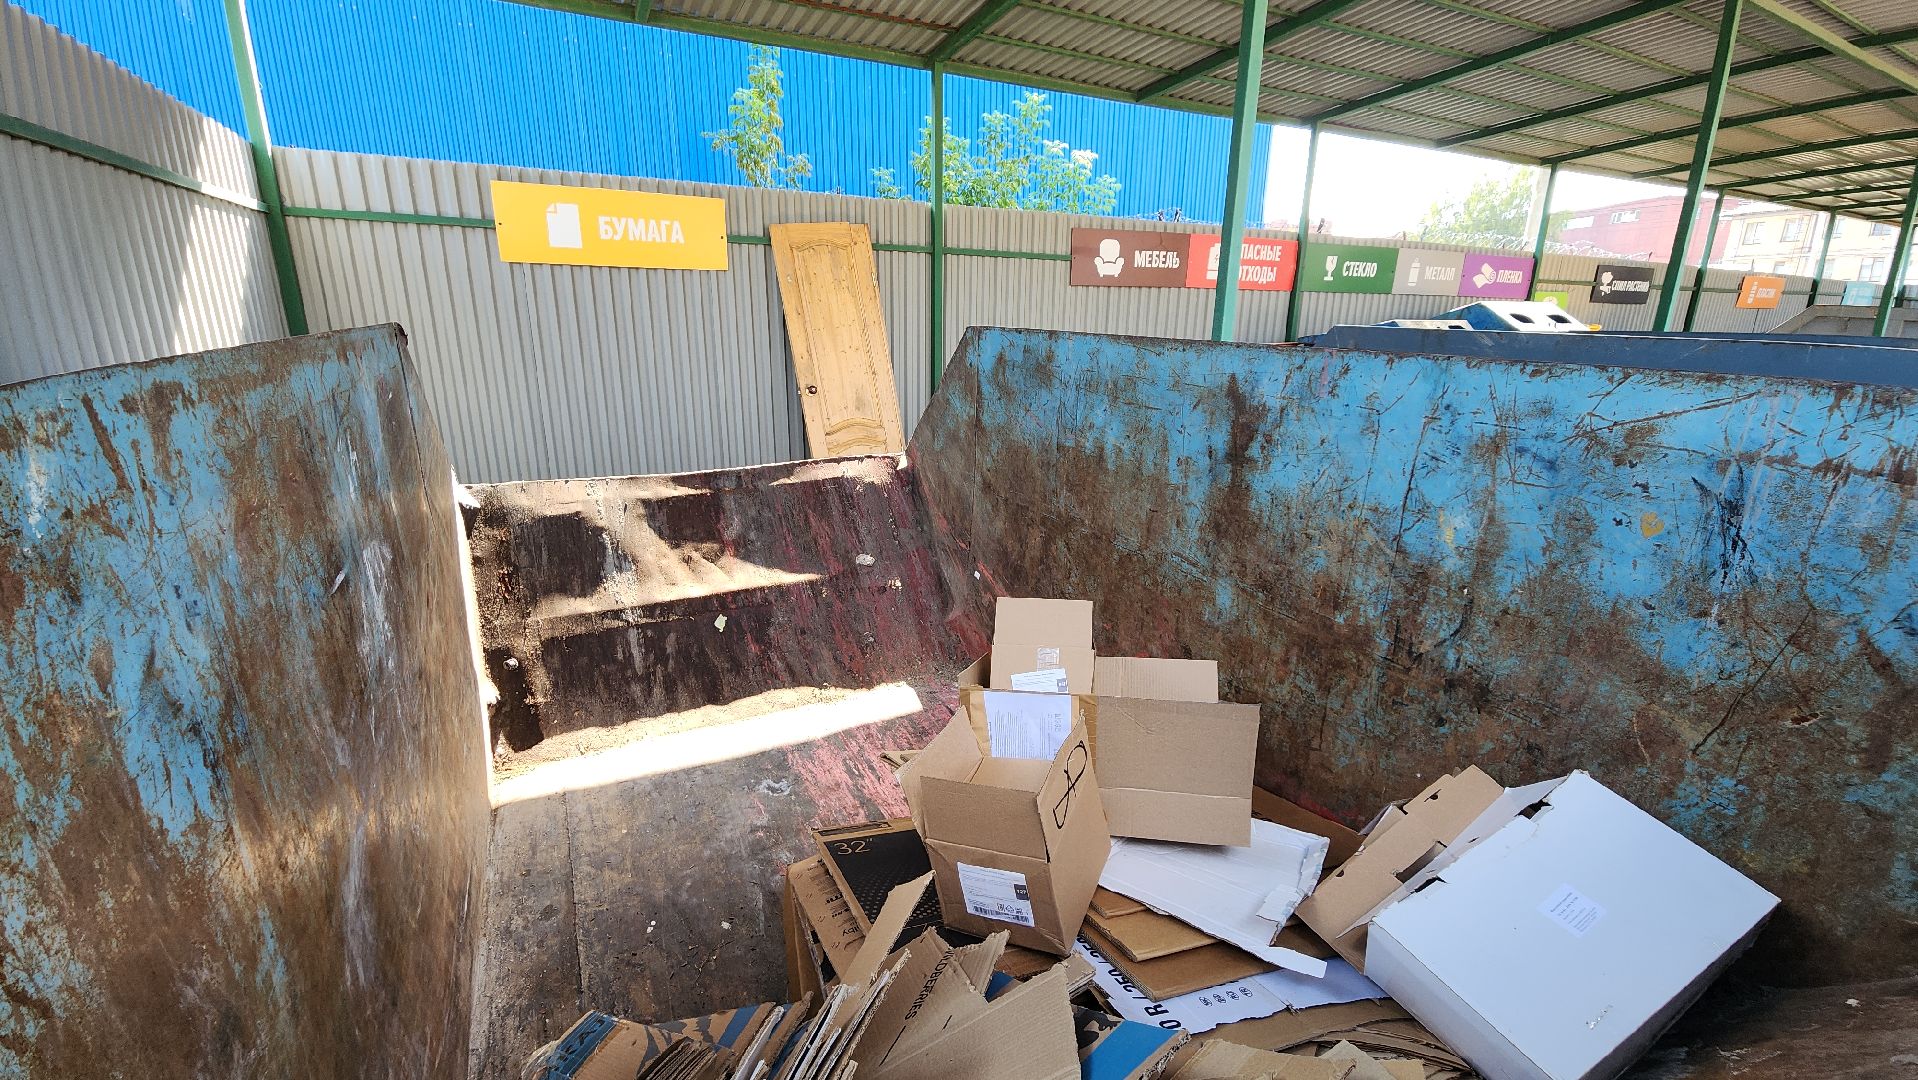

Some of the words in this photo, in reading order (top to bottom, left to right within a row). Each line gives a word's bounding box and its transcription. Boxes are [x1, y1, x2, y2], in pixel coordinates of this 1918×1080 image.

[598, 215, 685, 244] БУМАГА
[1134, 250, 1180, 269] МЕБЕЛЬ
[1241, 243, 1282, 262] ПАСНЫЕ
[1342, 260, 1377, 278] СТЕКЛО
[1424, 265, 1456, 281] МЕТАЛЛ
[834, 838, 871, 855] 32"
